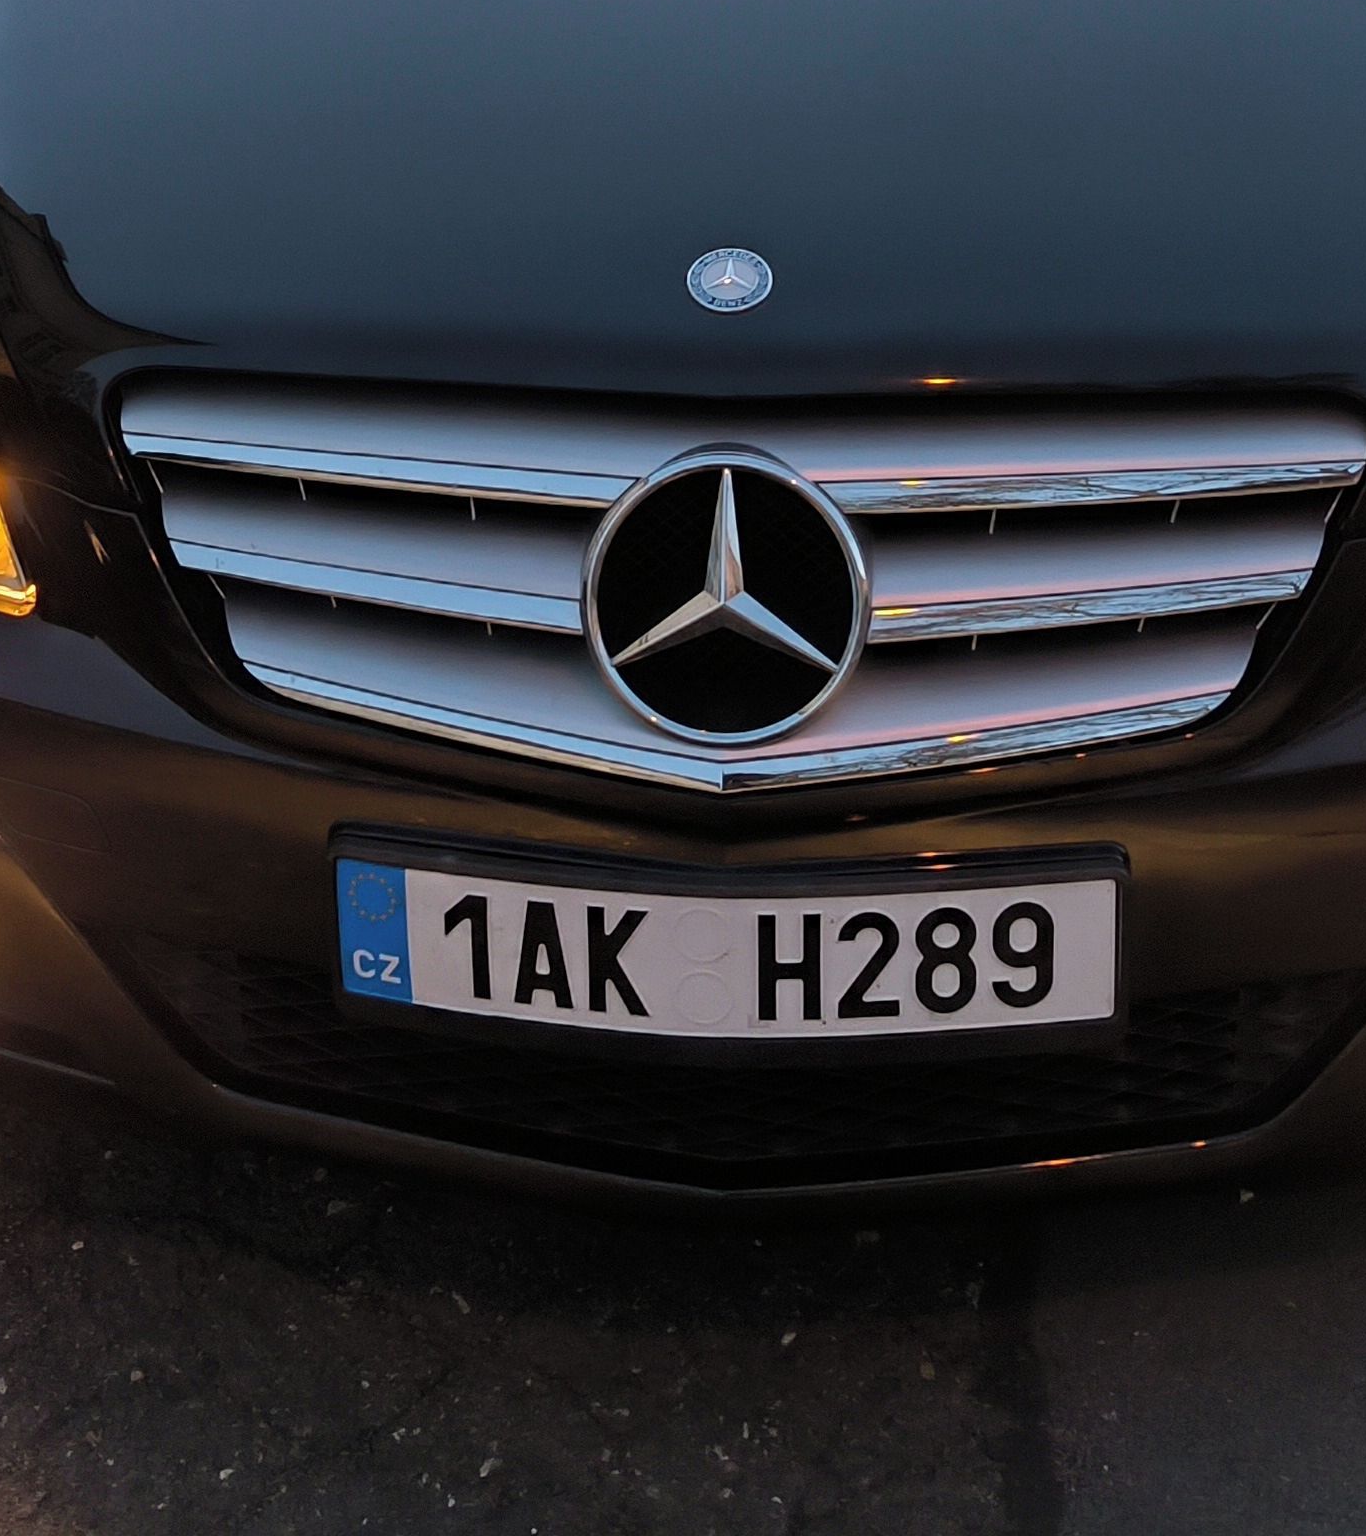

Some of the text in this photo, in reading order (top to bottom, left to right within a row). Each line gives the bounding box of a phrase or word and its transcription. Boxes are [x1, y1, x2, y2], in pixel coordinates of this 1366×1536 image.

[353, 949, 401, 984] CZ
[444, 894, 1054, 1020] 1AK H289
